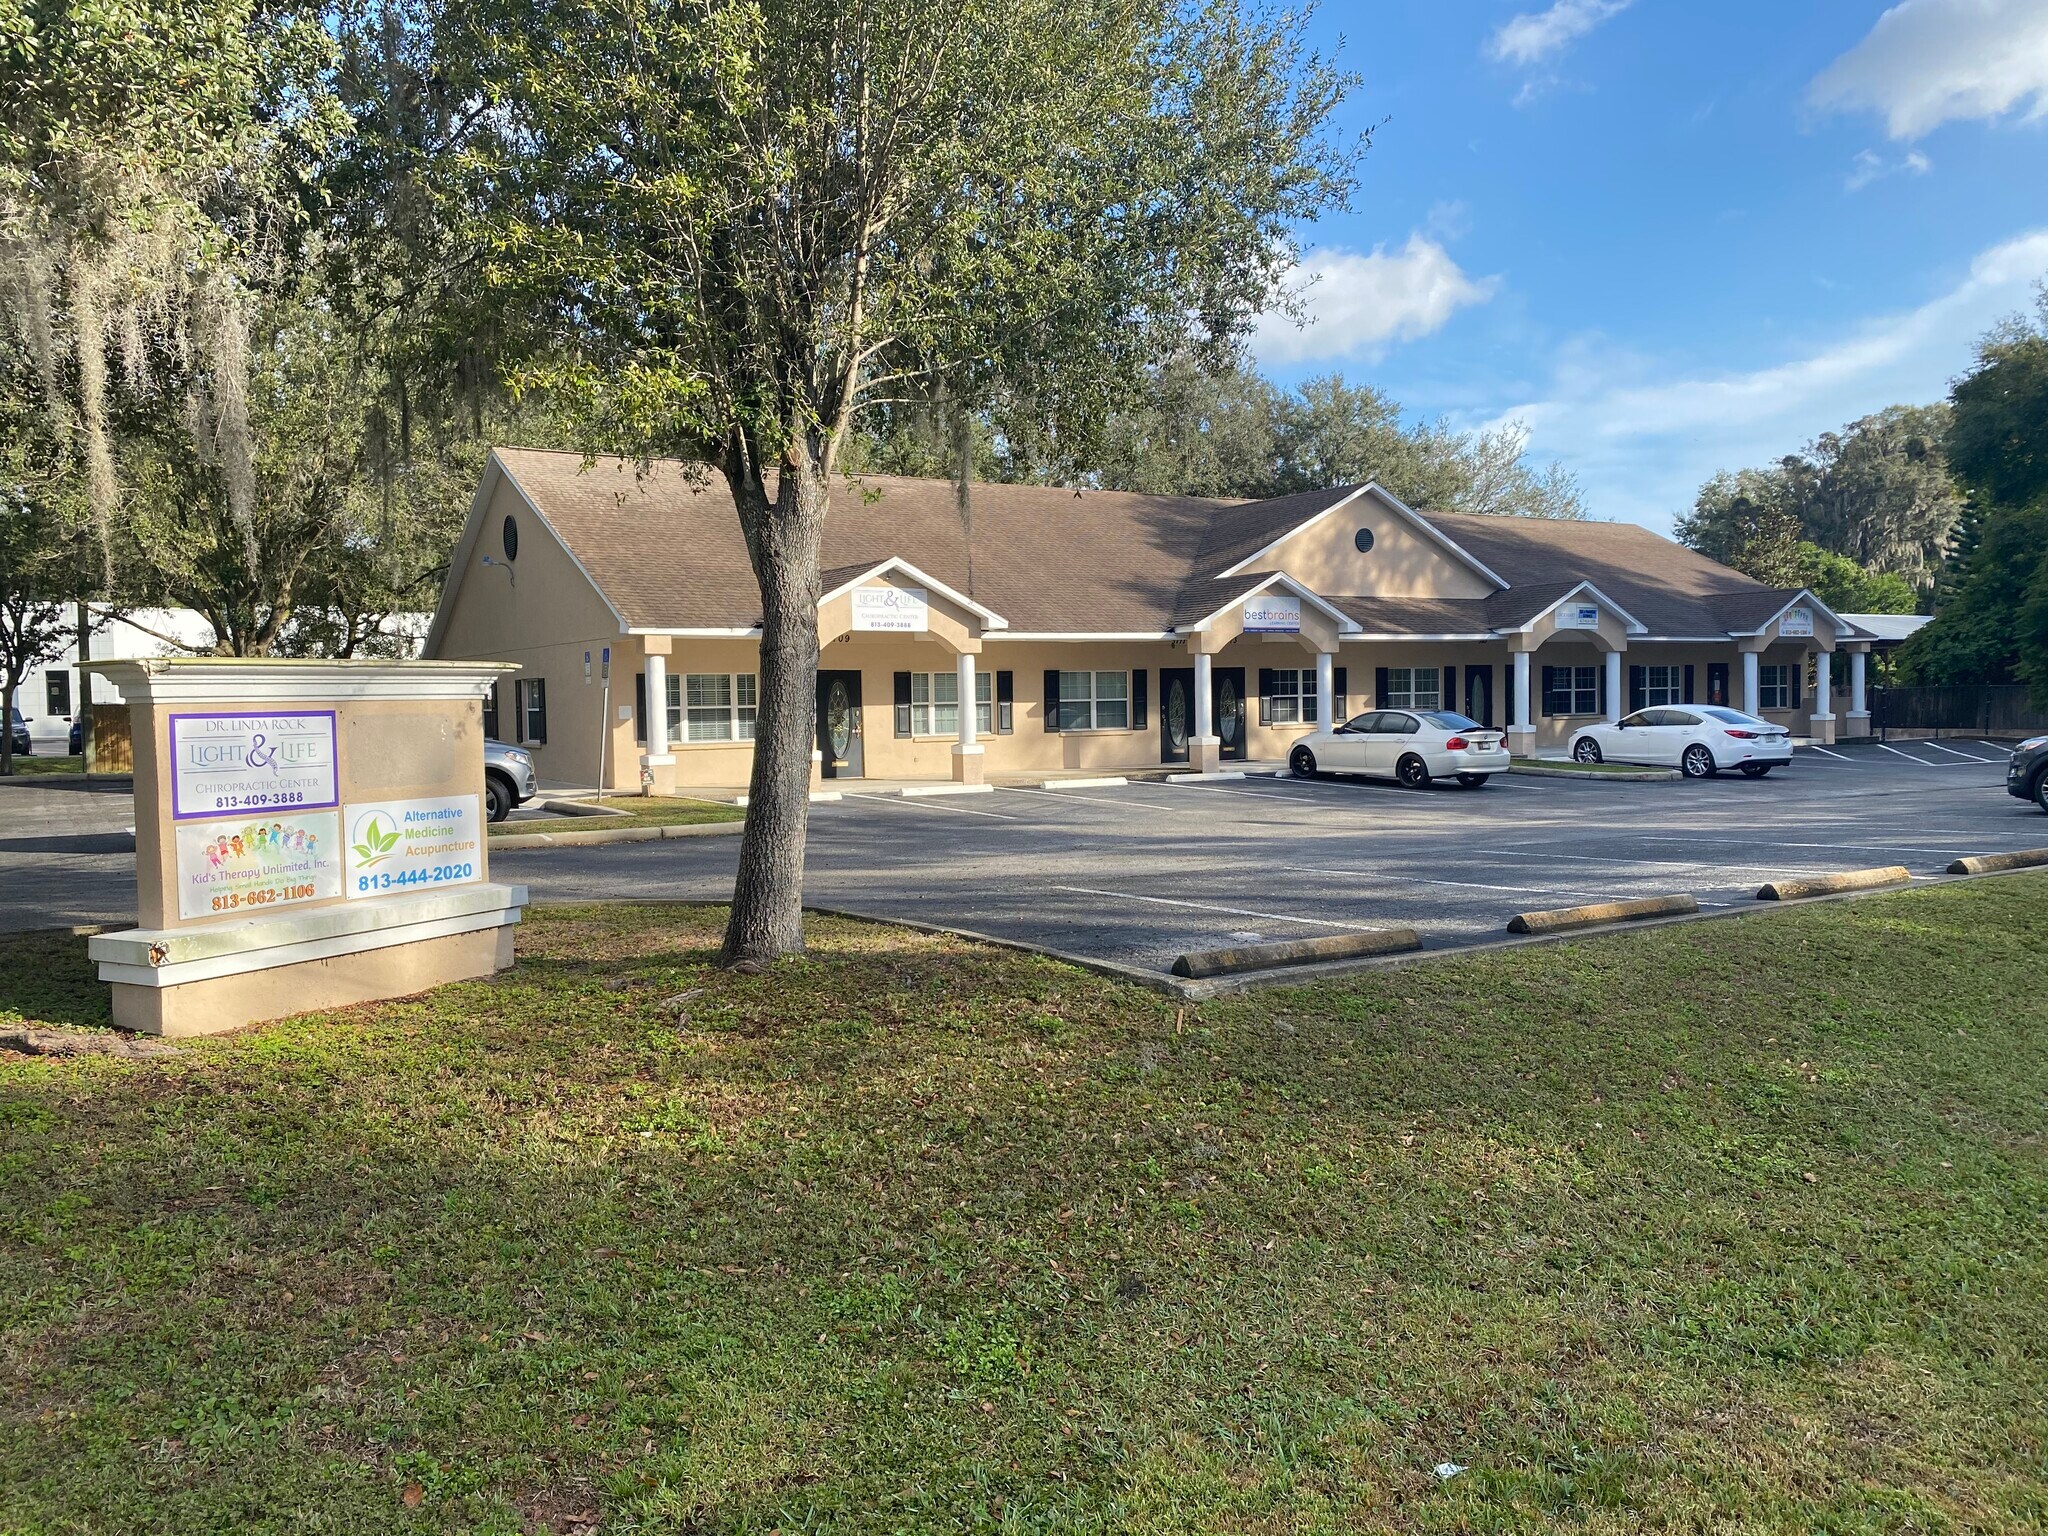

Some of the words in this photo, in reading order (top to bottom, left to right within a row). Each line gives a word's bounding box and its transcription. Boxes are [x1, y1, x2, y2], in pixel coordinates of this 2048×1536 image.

[1244, 609, 1300, 621] bestbrains
[206, 720, 229, 732] DR.
[231, 719, 269, 731] LINDA
[271, 718, 306, 730] ROCK
[190, 744, 246, 766] LIGHT
[246, 734, 279, 777] &
[280, 742, 318, 763] LIFE
[195, 780, 277, 794] CHIROPRACTIC
[278, 778, 319, 788] CENTER
[216, 792, 304, 808] 813-409-3888
[404, 807, 463, 823] Alternative
[405, 826, 454, 840] Medicine
[405, 841, 475, 857] Acupuncture
[191, 872, 217, 885] Kid's
[218, 868, 261, 882] Therapy
[314, 859, 330, 869] Inc.
[358, 863, 473, 892] 813-444-2020
[211, 883, 316, 911] 813-662-1106
